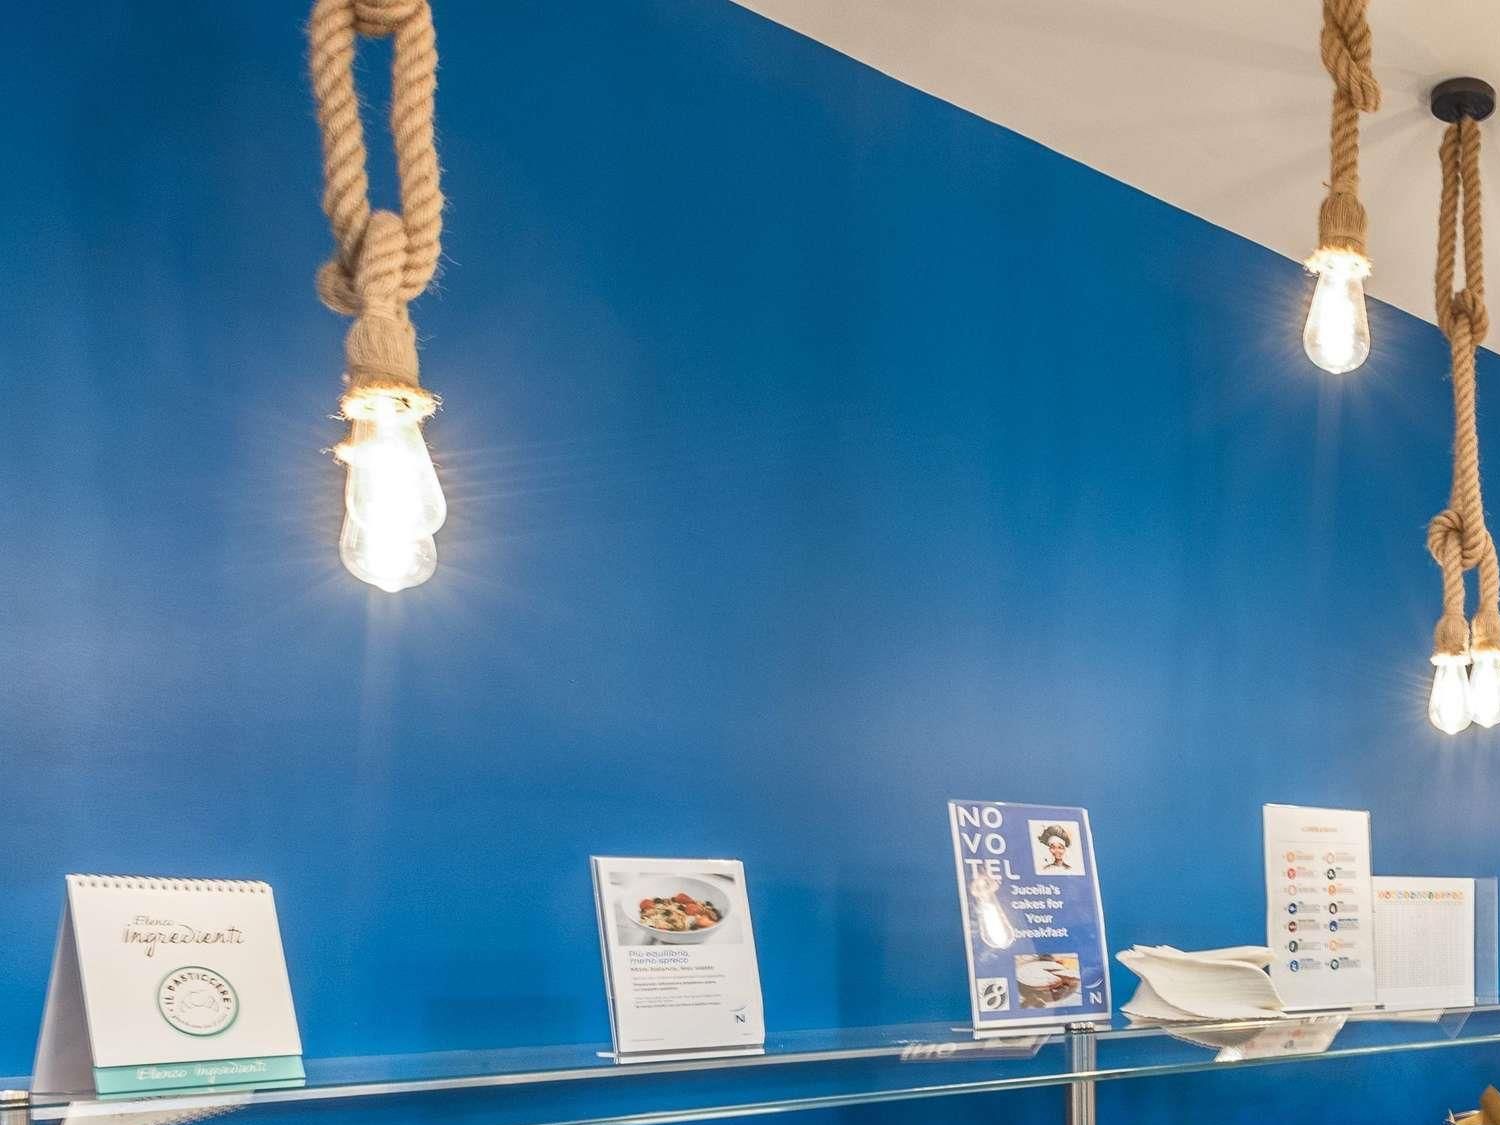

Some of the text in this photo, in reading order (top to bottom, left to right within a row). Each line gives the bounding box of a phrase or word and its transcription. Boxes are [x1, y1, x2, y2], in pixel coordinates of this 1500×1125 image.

[955, 806, 1003, 829] NO
[961, 833, 1007, 855] VO
[964, 858, 1021, 881] TEL
[1024, 913, 1054, 924] Your
[1015, 927, 1070, 939] breakfast
